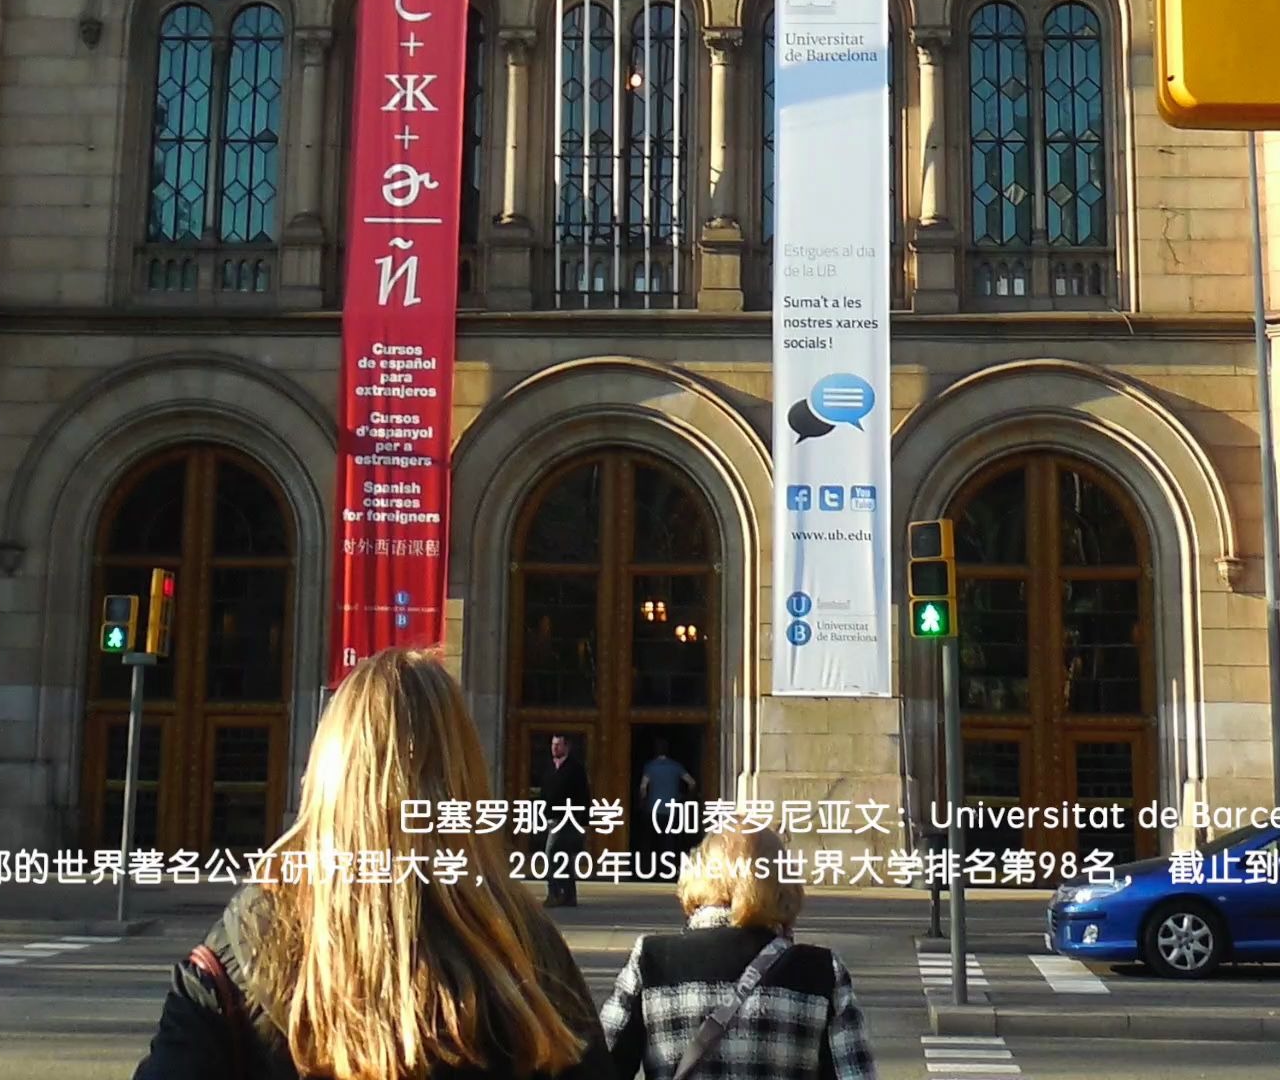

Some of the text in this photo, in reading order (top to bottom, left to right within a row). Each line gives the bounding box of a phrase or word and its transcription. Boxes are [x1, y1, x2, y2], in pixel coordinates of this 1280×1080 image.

[784, 31, 865, 46] Universitat
[784, 48, 878, 62] de Barcelona
[380, 74, 439, 112] Ж
[783, 244, 876, 261] Estigues al dia
[783, 264, 837, 277] de la UB
[783, 295, 862, 309] Suma't a les
[783, 317, 879, 329] nostres xarxes
[372, 342, 423, 356] Cursos
[357, 357, 437, 371] de español
[380, 373, 413, 384] para
[355, 385, 437, 399] extranjeros
[370, 411, 420, 424] Cursos
[356, 426, 433, 441] d'espanyol
[375, 442, 413, 453] per a
[354, 454, 432, 468] estrangers
[363, 481, 421, 495] Spanish
[363, 497, 421, 508] courses
[342, 508, 440, 525] for foreigners
[791, 529, 872, 542] www.ub.edu
[343, 538, 440, 557] 对外西语课程
[816, 620, 869, 631] Universitat
[816, 632, 878, 643] de Barcelona
